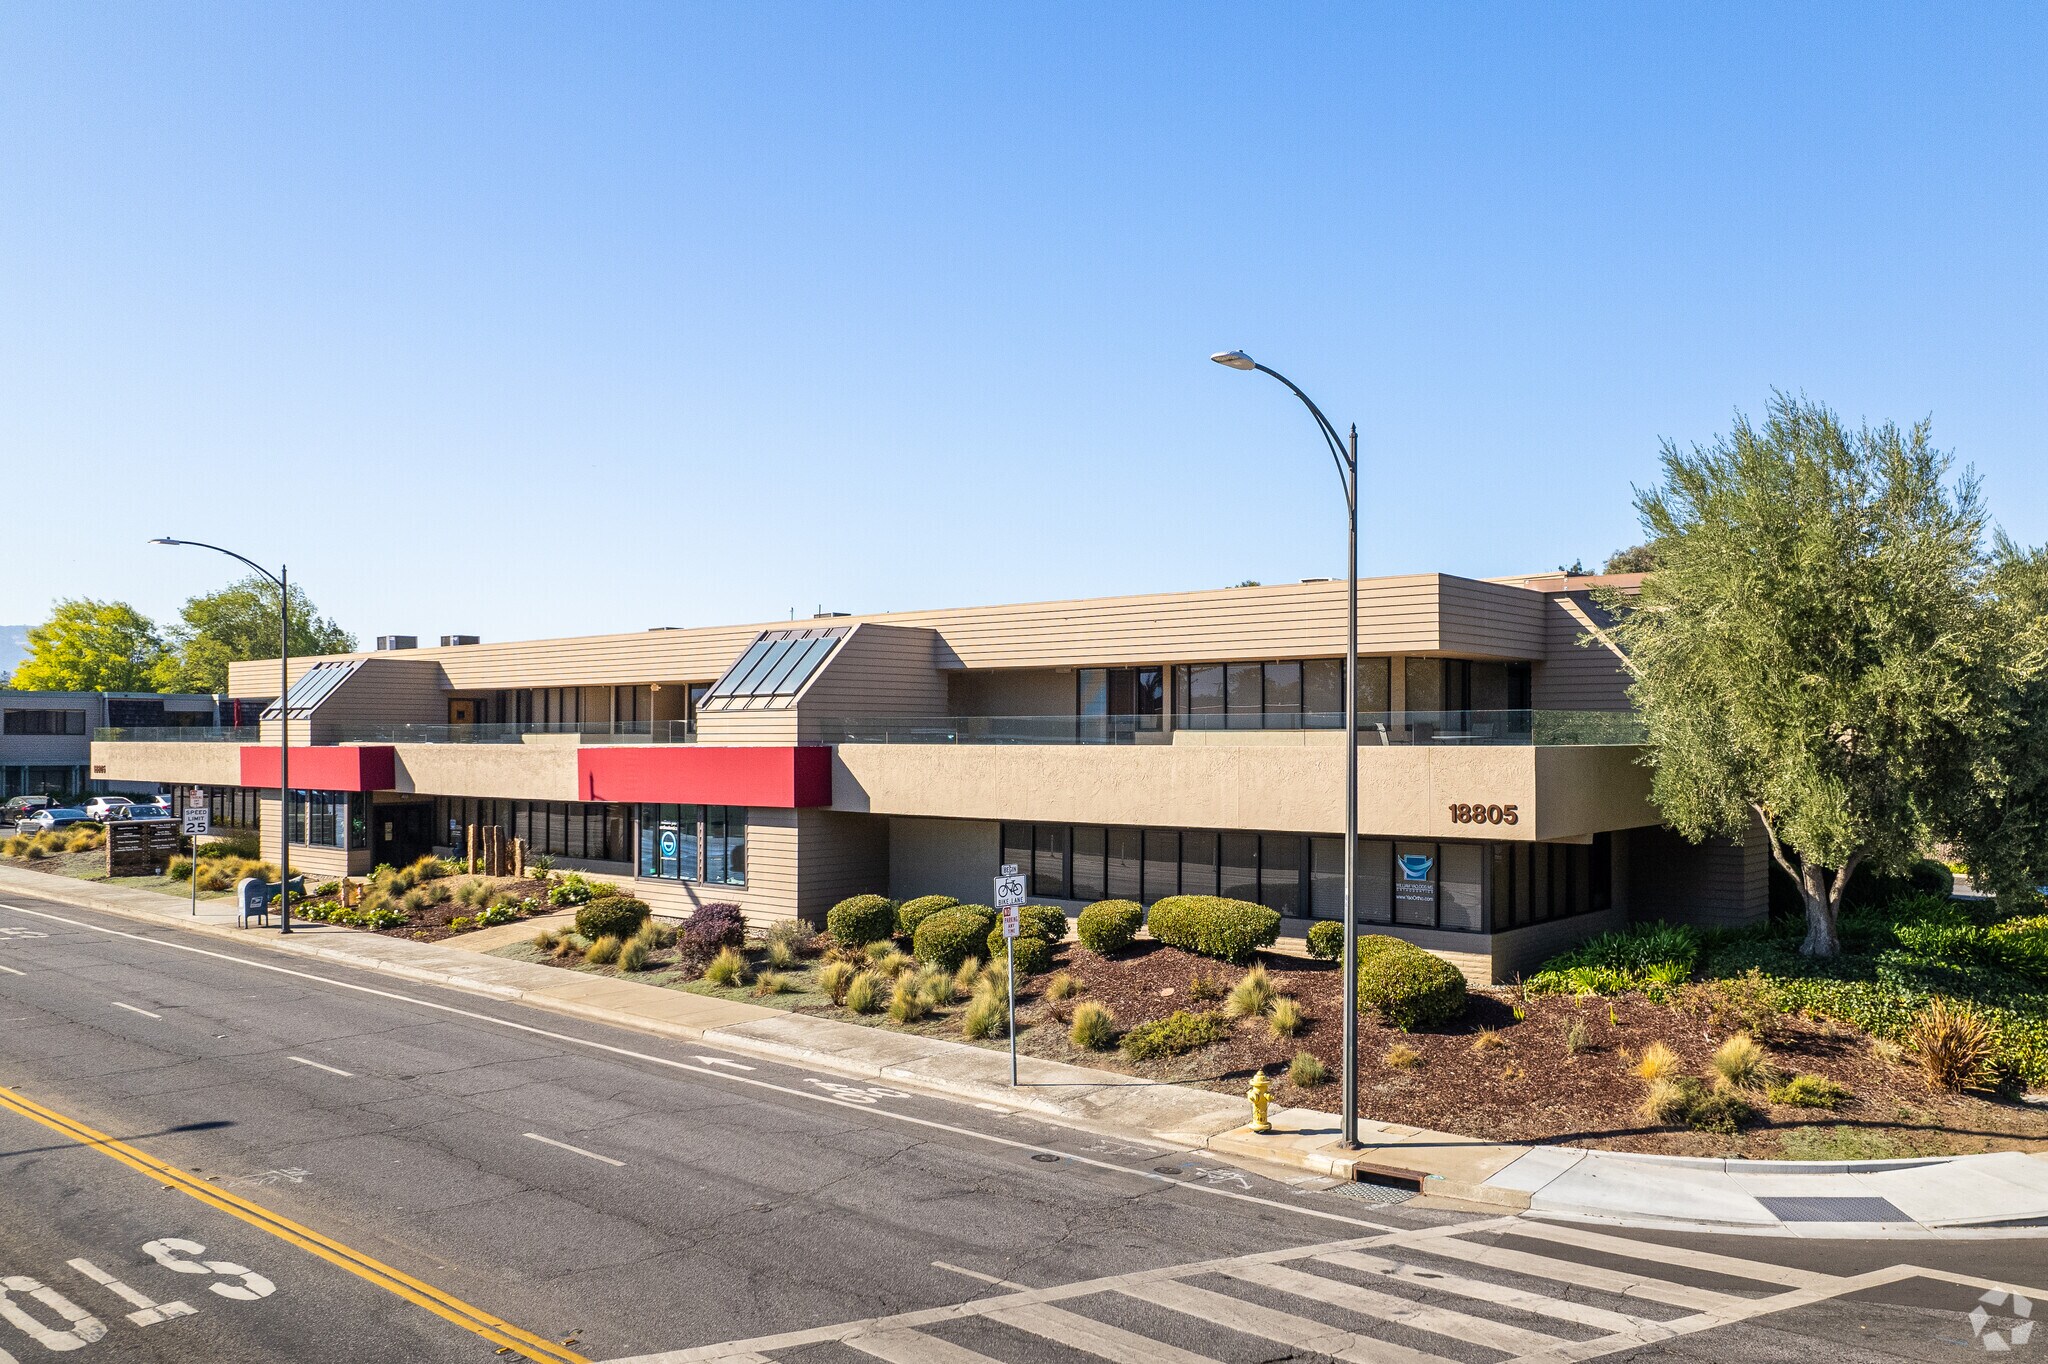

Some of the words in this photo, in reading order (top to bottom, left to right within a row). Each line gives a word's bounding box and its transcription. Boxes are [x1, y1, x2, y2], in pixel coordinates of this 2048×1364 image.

[1448, 803, 1519, 825] 18805
[186, 822, 206, 833] 25
[0, 1237, 277, 1364] STO
